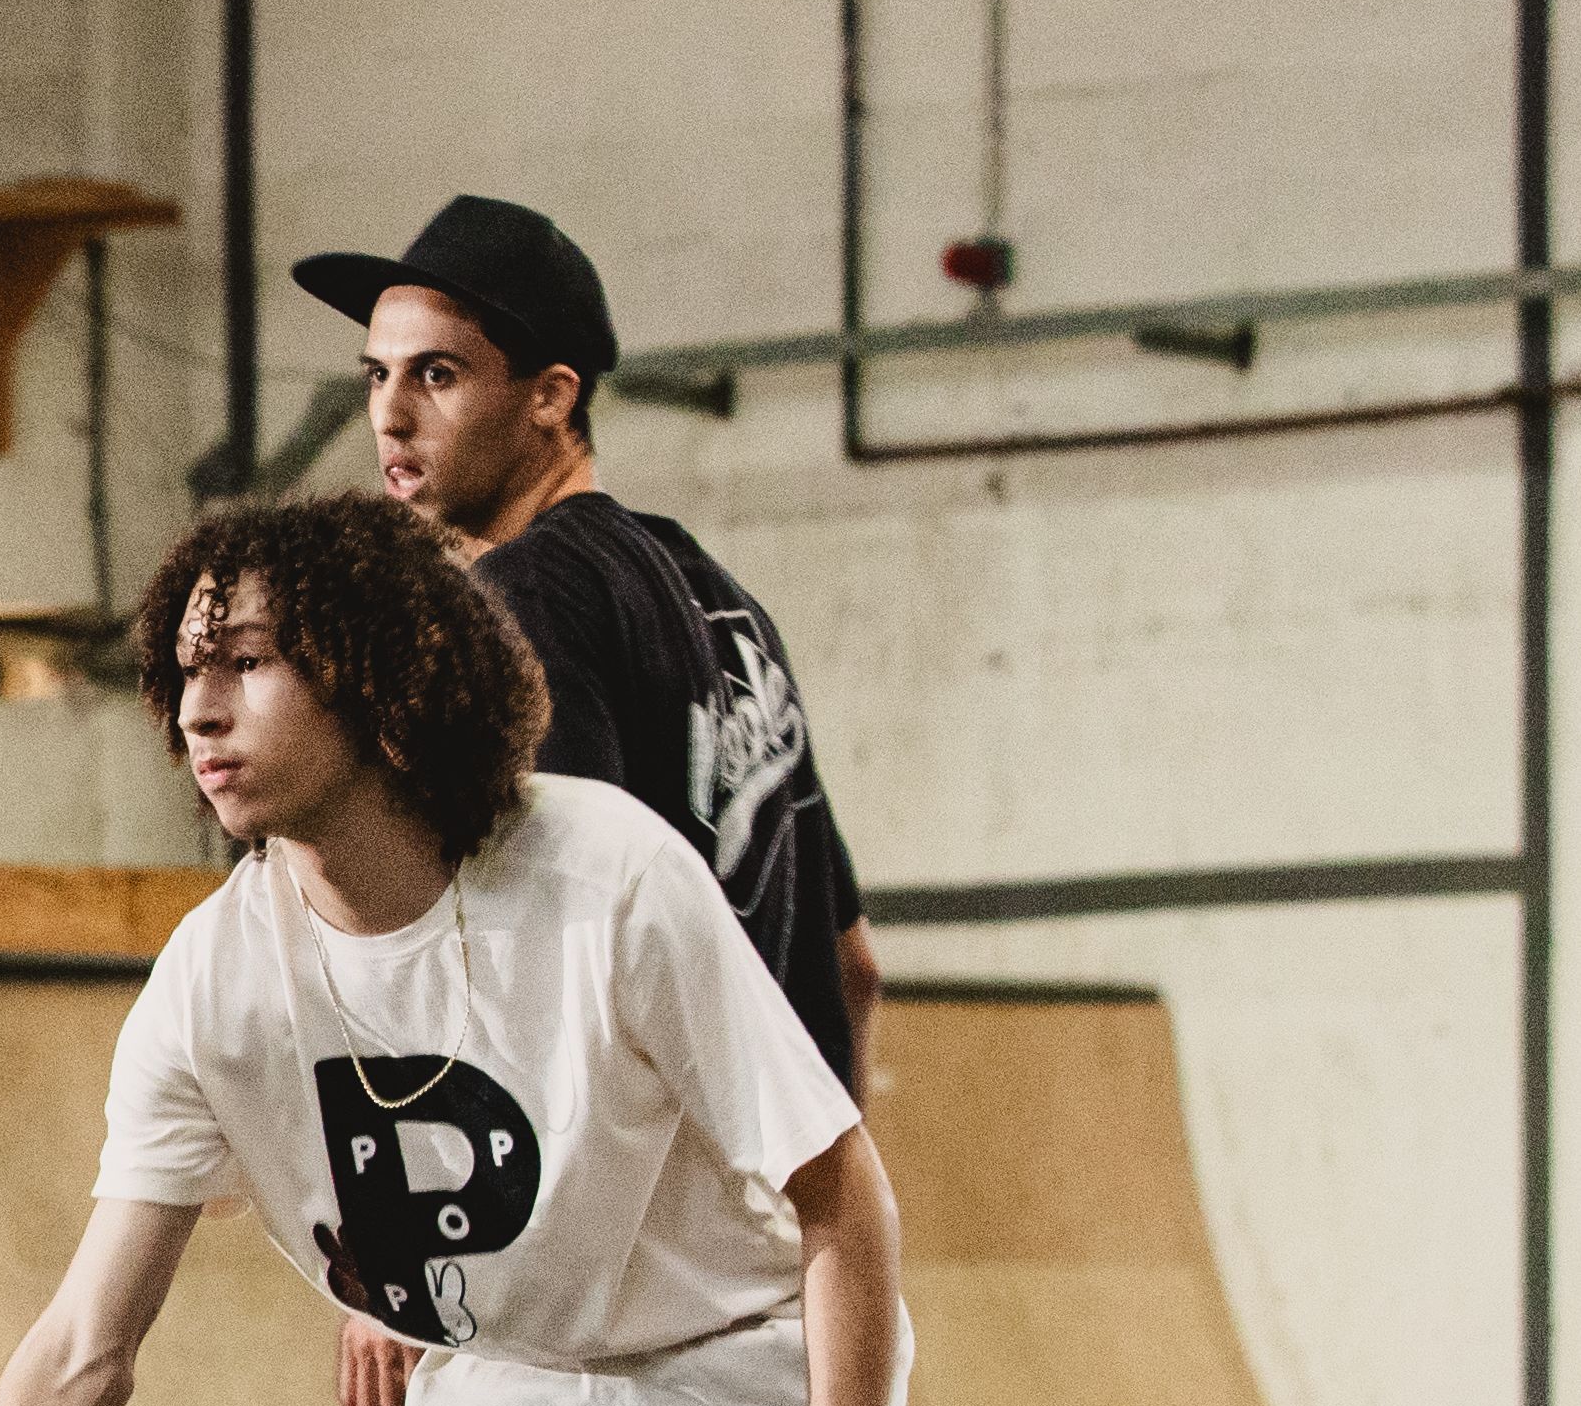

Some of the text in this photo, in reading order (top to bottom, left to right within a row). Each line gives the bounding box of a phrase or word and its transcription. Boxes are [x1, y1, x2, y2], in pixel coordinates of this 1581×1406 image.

[351, 1129, 514, 1174] P P
[383, 1283, 408, 1312] P
